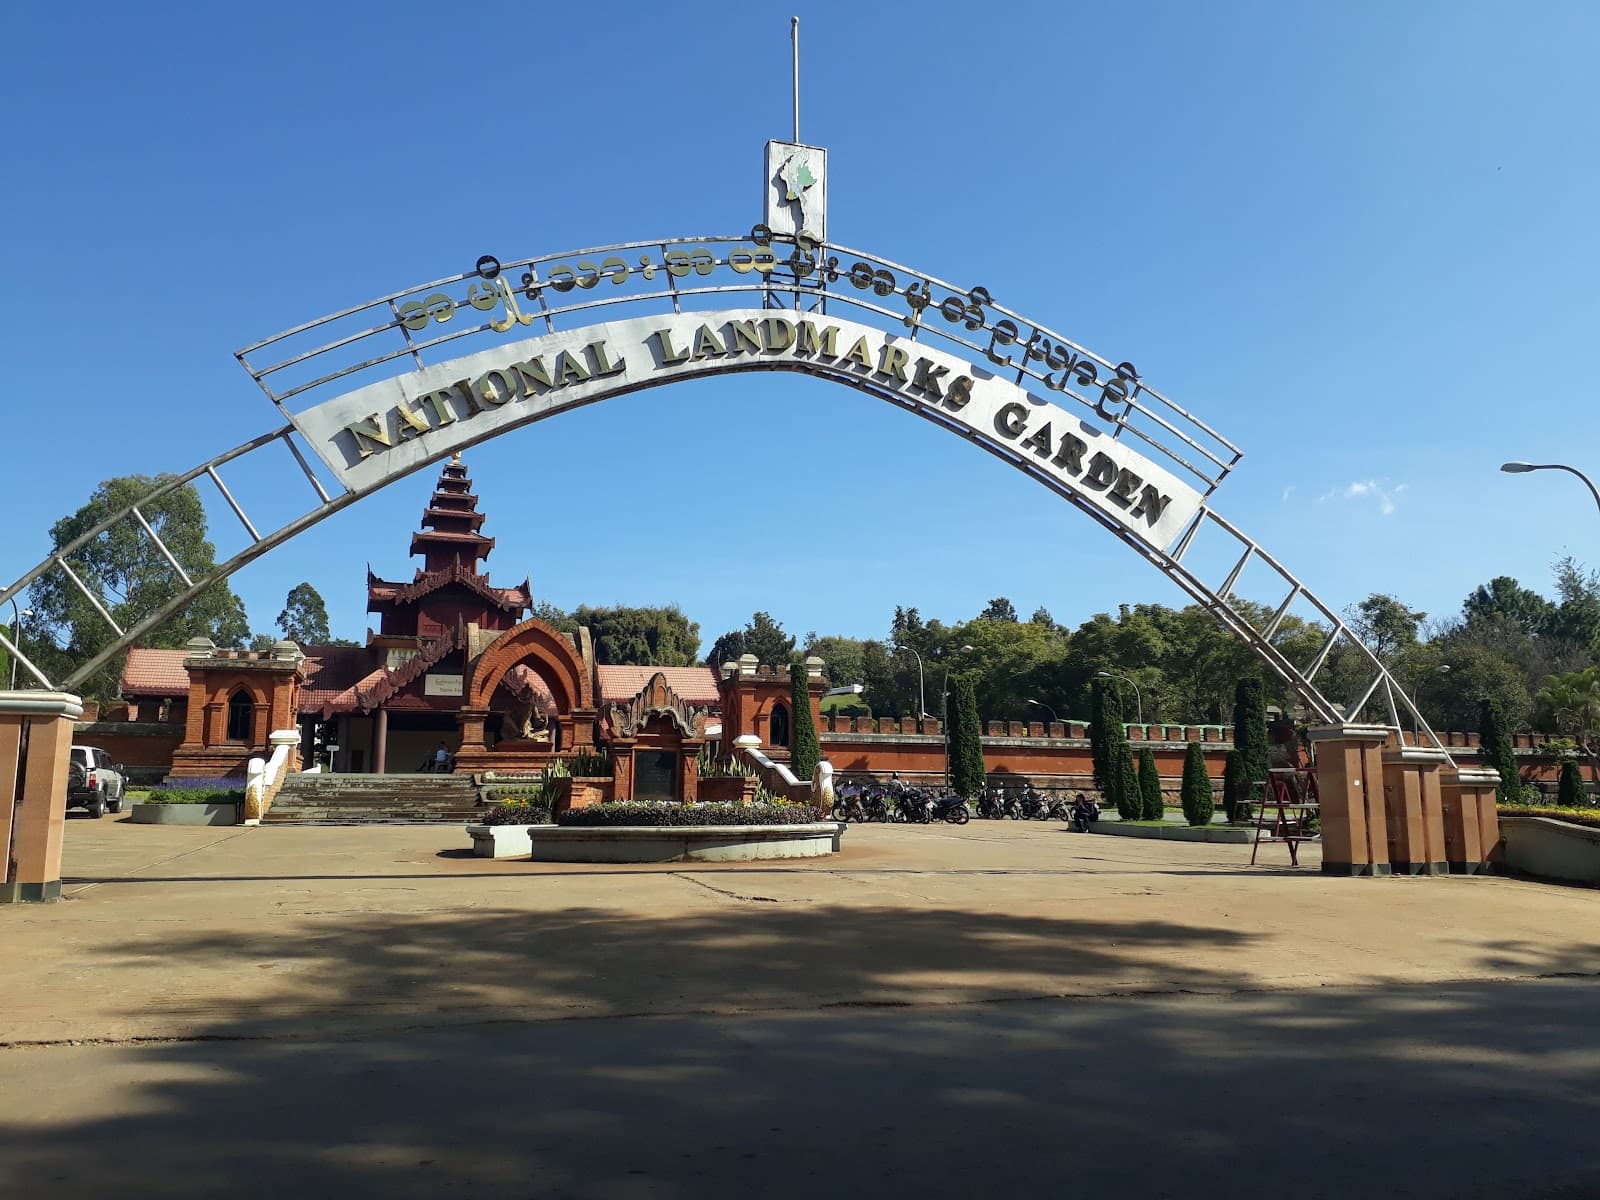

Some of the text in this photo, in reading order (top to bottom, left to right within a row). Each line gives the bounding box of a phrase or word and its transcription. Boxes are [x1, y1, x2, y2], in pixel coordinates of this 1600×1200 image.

[340, 316, 1173, 528] NATIONAL LANDMARKS GARDEN
